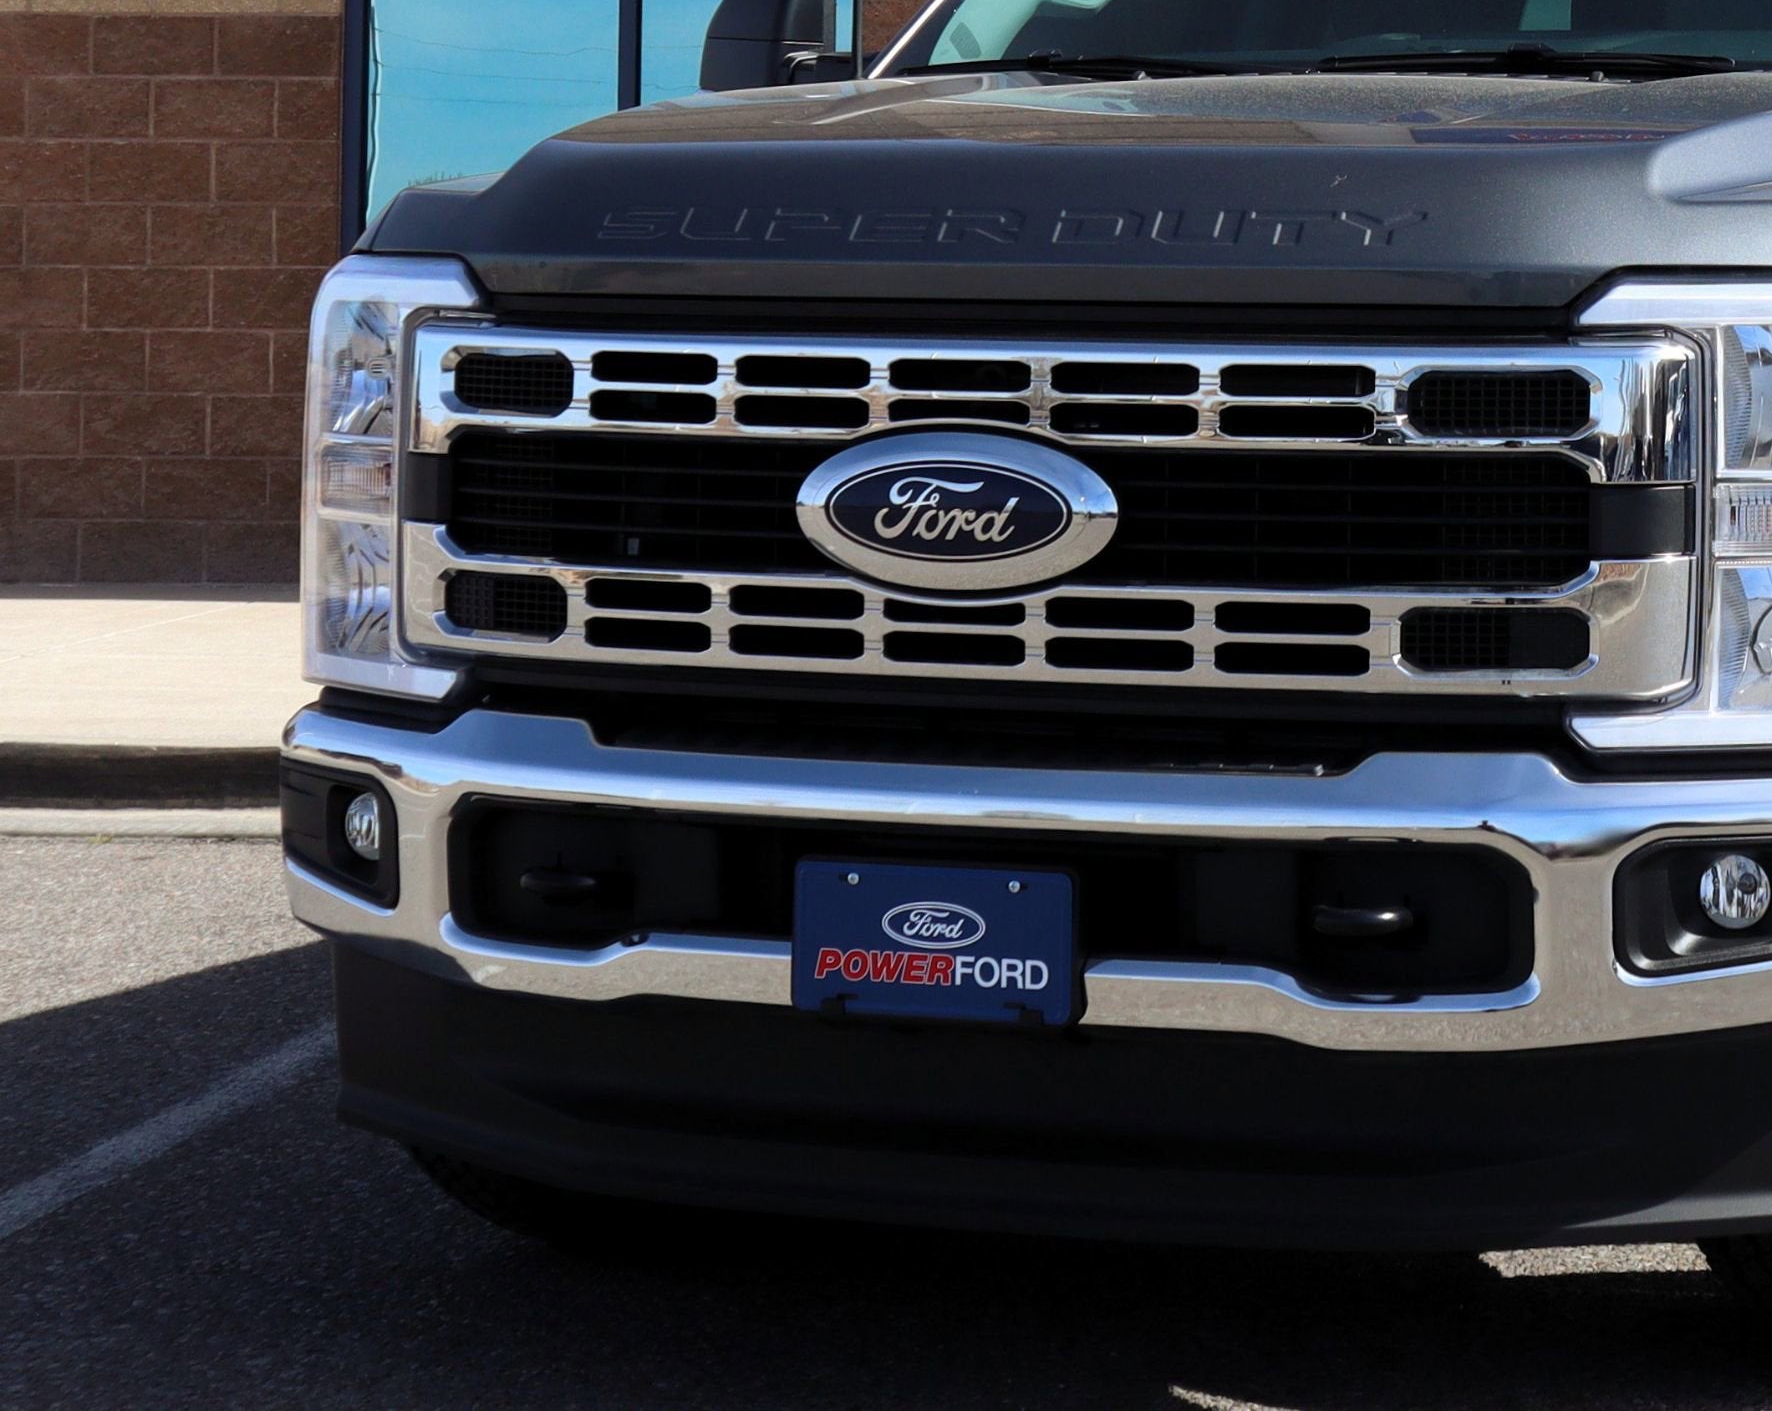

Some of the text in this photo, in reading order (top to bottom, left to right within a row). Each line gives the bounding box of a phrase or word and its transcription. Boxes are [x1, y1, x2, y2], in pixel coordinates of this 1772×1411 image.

[597, 205, 1430, 247] SUPER DUTY
[873, 476, 1021, 543] Ford
[902, 909, 965, 939] Ford
